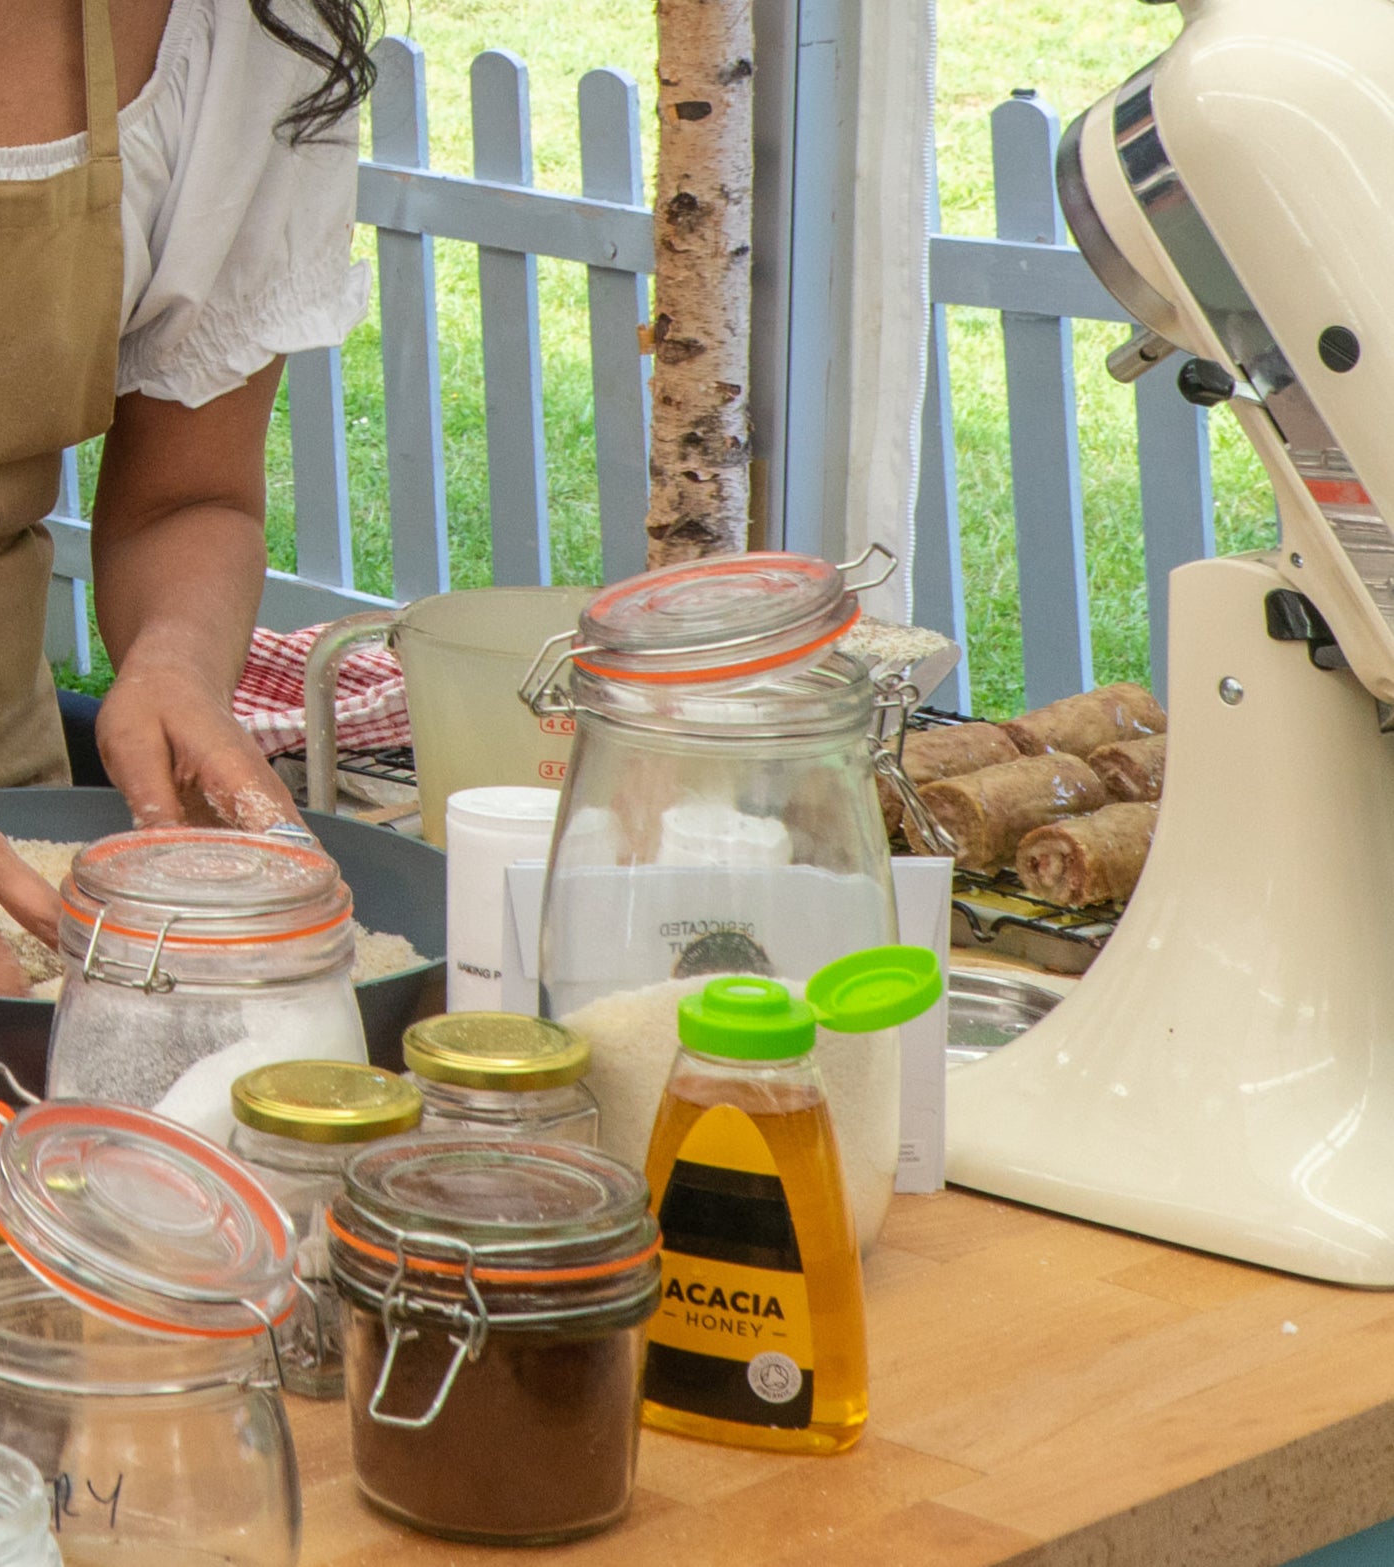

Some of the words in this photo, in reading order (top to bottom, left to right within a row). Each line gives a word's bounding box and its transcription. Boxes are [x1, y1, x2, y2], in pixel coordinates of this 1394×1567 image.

[546, 719, 554, 730] 4
[544, 764, 553, 776] 3
[665, 1278, 784, 1320] ACACIA
[686, 1310, 764, 1339] HONEY
